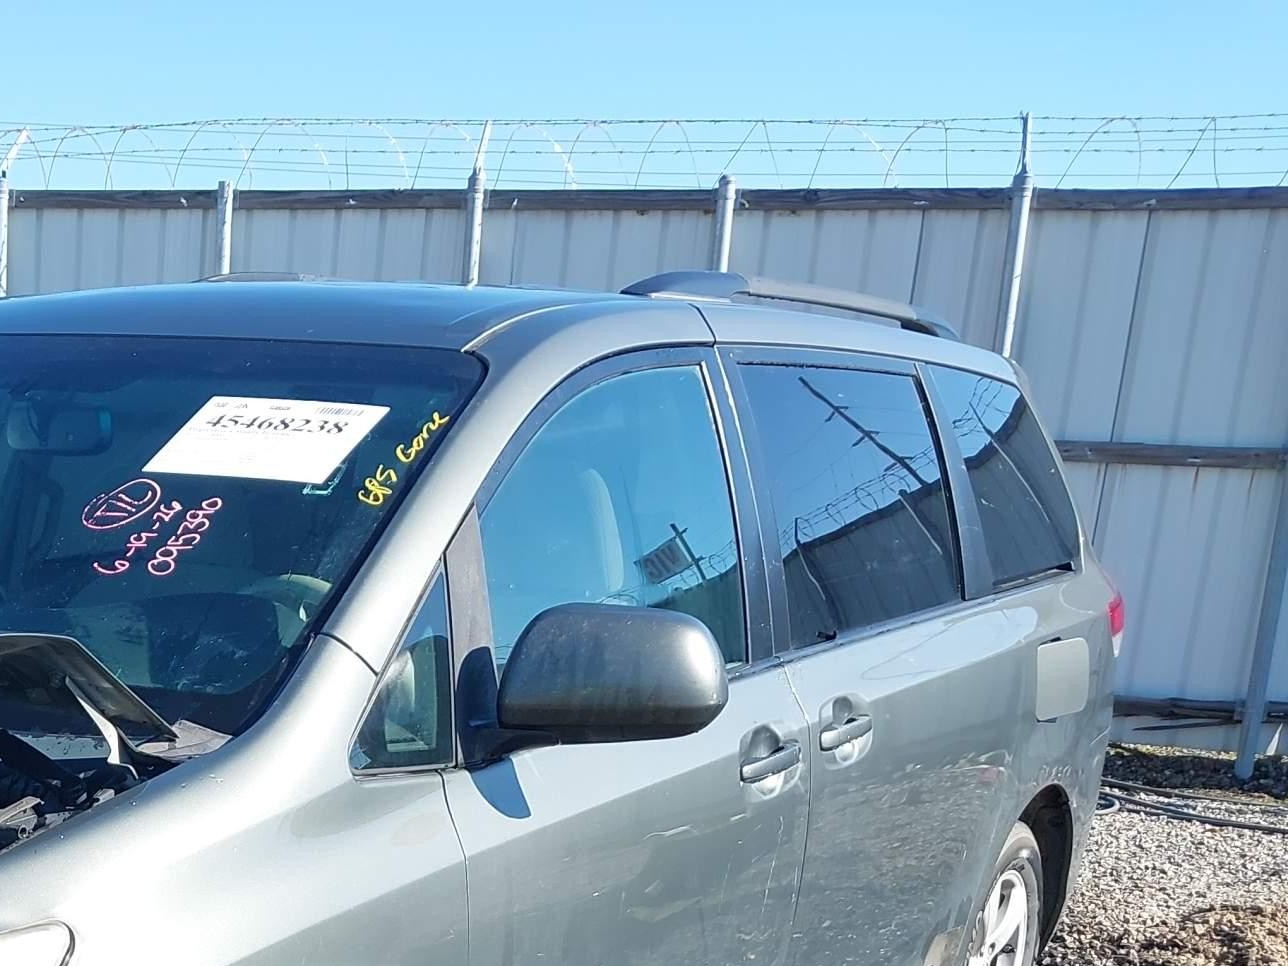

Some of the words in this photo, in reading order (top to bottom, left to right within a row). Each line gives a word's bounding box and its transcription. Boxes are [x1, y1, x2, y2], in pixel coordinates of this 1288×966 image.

[205, 413, 350, 435] 45468238
[395, 411, 451, 463] Gone
[147, 497, 223, 575] 095390
